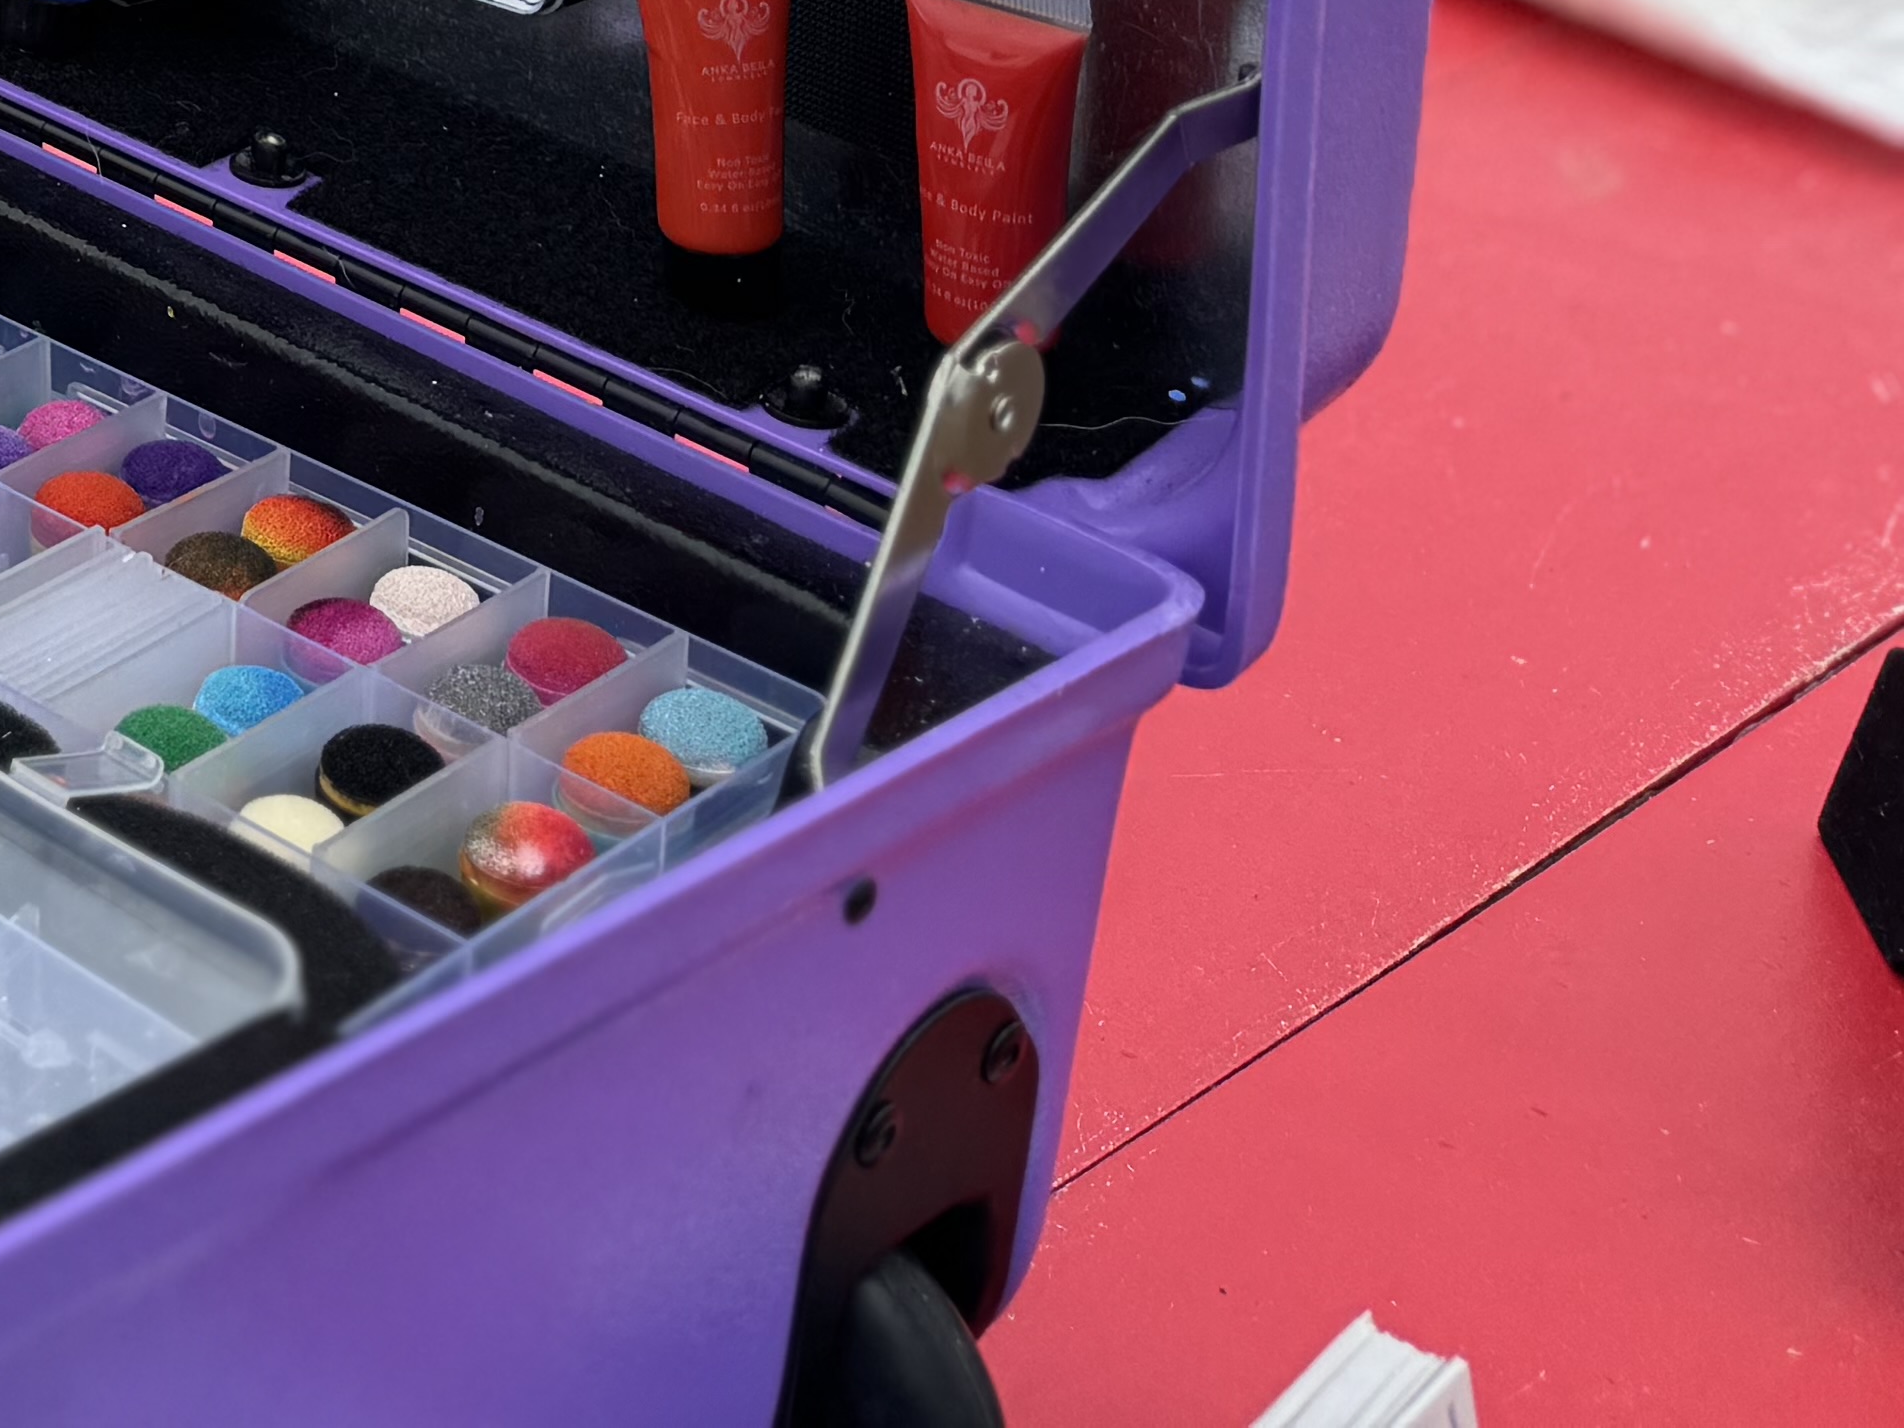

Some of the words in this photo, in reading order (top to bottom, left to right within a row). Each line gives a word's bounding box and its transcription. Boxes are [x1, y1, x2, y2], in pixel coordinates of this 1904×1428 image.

[676, 111, 709, 126] Face
[715, 114, 727, 126] &
[732, 110, 766, 125] Body
[930, 141, 963, 159] ANKA
[936, 194, 945, 207] &
[950, 200, 987, 222] Body
[992, 210, 1033, 225] Paint
